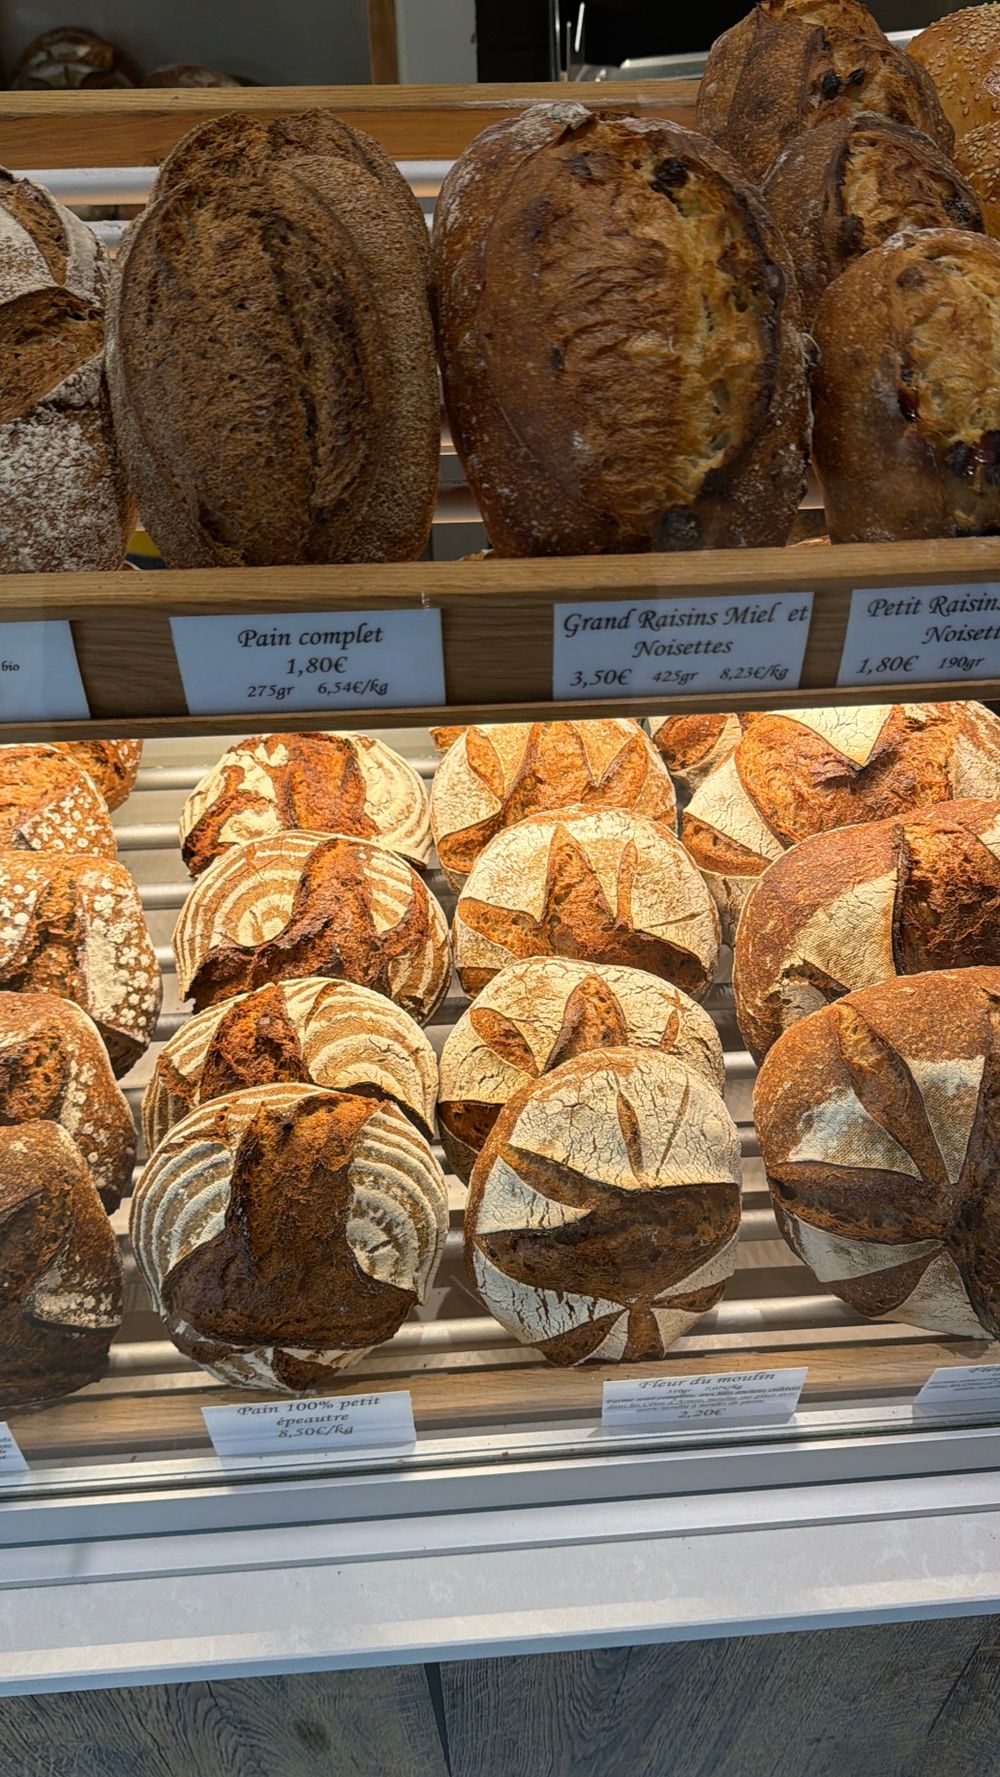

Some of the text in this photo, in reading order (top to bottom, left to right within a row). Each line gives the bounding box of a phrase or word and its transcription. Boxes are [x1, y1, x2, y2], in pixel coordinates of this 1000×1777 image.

[867, 596, 922, 617] Petit
[563, 602, 809, 638] Grand Raisins Miel et
[237, 622, 384, 650] Pain complet
[631, 639, 734, 659] Noisettes
[1, 660, 20, 672] bio
[286, 656, 349, 677] 1,80€
[856, 655, 985, 676] 1,80€ 190gr
[570, 664, 790, 689] 3,50€ 425gr 8,23€/kg
[247, 678, 389, 700] 275gr 6,54€/kg
[638, 1371, 775, 1389] Fleur du moulin
[236, 1396, 381, 1416] Pain 100% petit
[678, 1408, 727, 1419] 2,20€
[276, 1412, 350, 1428] épeautre
